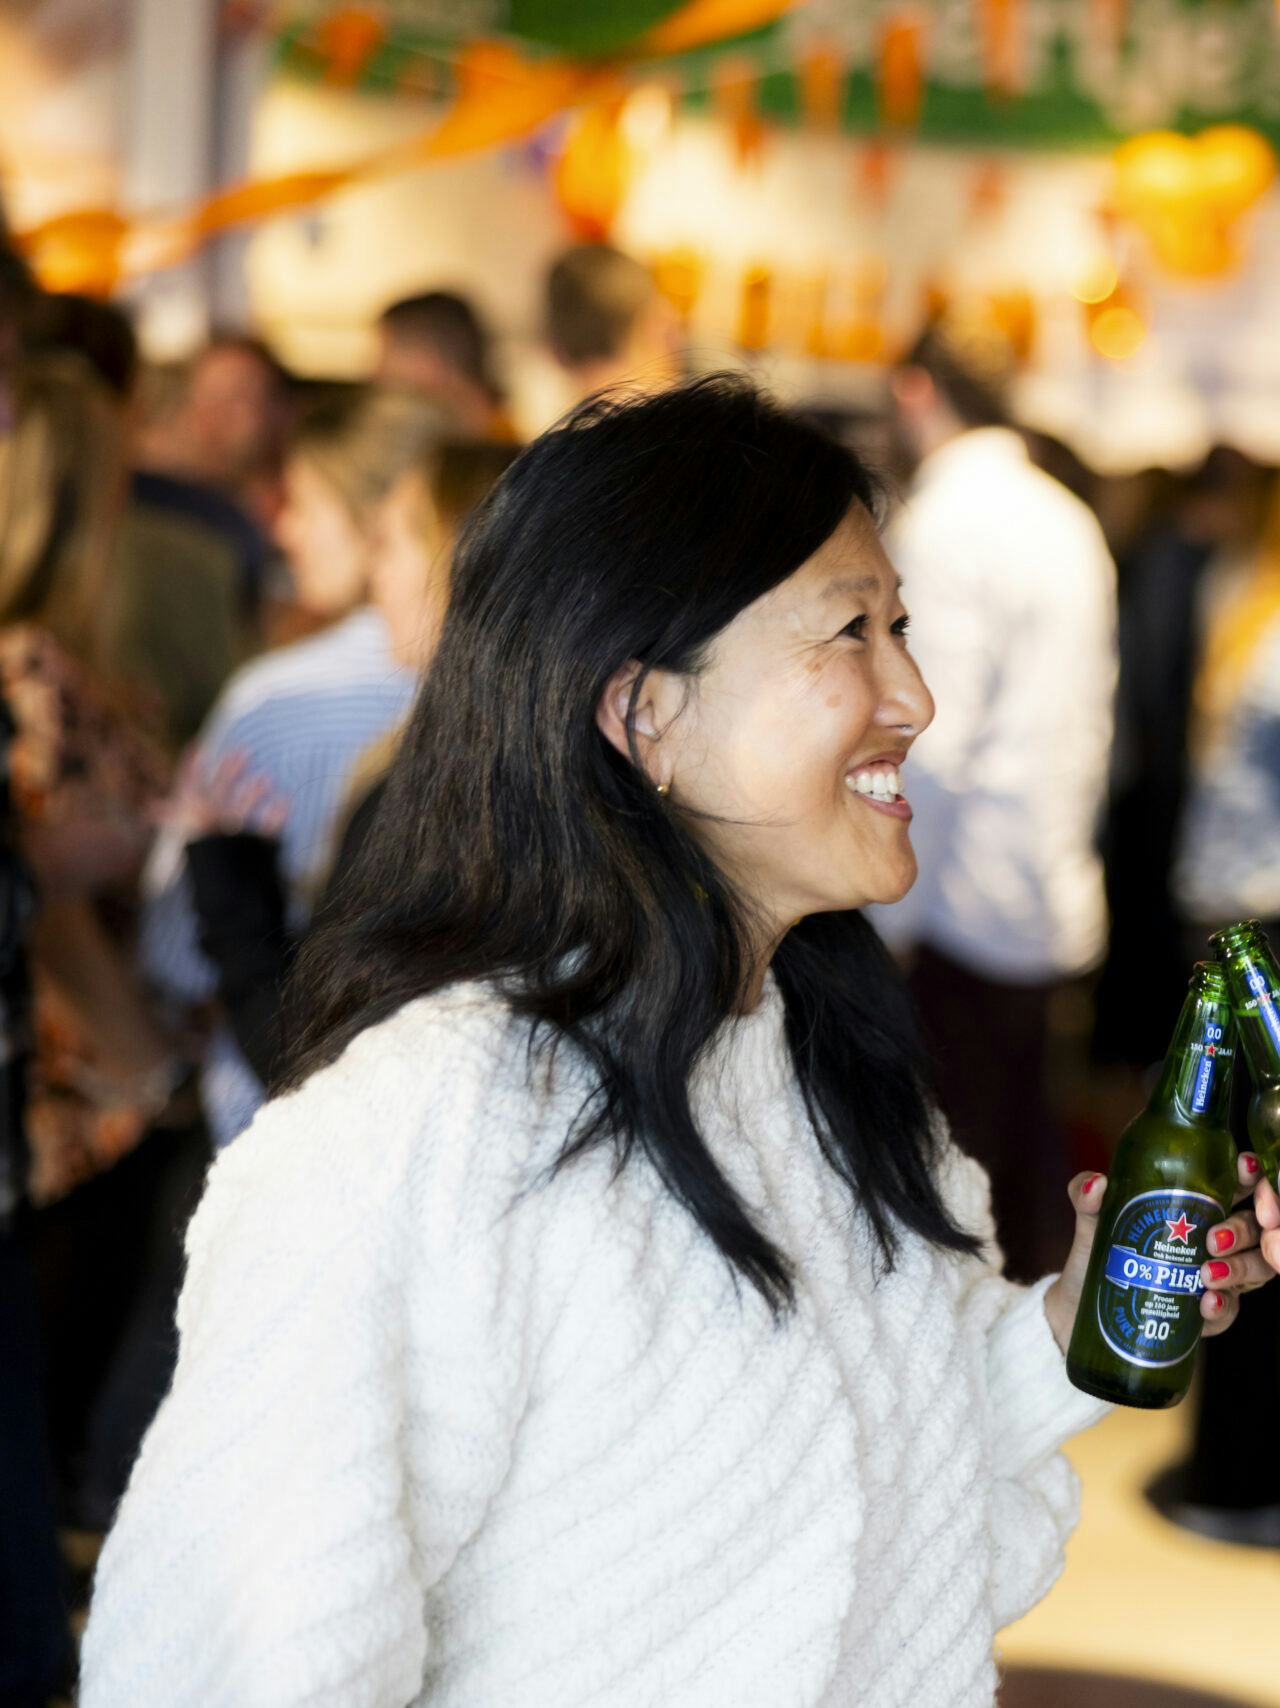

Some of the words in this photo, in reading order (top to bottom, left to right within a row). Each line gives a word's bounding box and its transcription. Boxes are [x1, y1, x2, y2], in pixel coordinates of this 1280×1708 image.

[1244, 999, 1258, 1010] 150
[1207, 1027, 1222, 1040] 0.0
[1190, 1042, 1203, 1052] 150
[1195, 1059, 1213, 1107] Heineken
[1153, 1241, 1197, 1256] Heineken
[1123, 1258, 1153, 1281] 0%
[1153, 1294, 1175, 1303] Proost
[1113, 1306, 1135, 1339] PURE
[1144, 1319, 1170, 1341] 0.0
